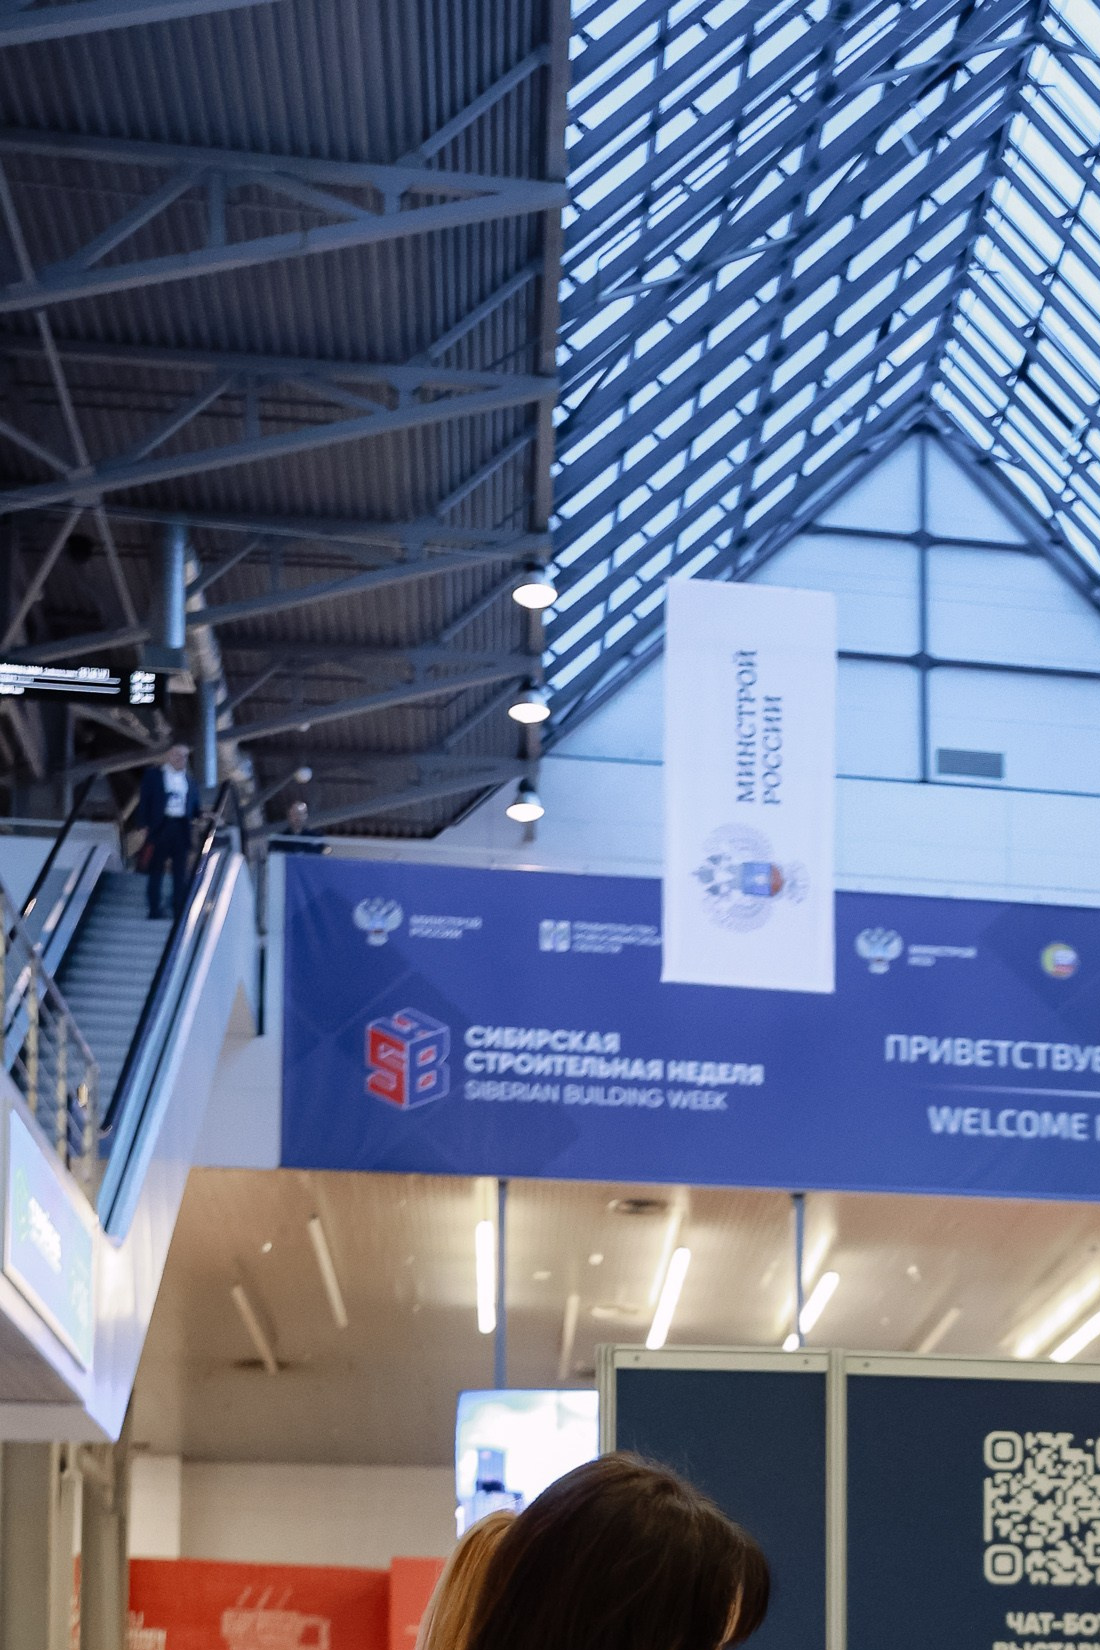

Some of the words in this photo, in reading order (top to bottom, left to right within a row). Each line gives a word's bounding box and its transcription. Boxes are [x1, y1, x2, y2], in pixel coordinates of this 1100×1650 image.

[732, 650, 758, 802] МИНСТРОЙ
[762, 696, 783, 804] РОССИИ
[464, 1025, 621, 1053] СИБИРСКАЯ
[463, 1051, 664, 1081] СТРОИТЕЛЬНАЯ
[667, 1060, 765, 1086] НЕДЕЛЯ
[463, 1079, 560, 1103] SIBERIAN
[563, 1084, 664, 1108] BUILDING
[667, 1089, 728, 1110] WEEK
[928, 1106, 1088, 1140] WELCOME
